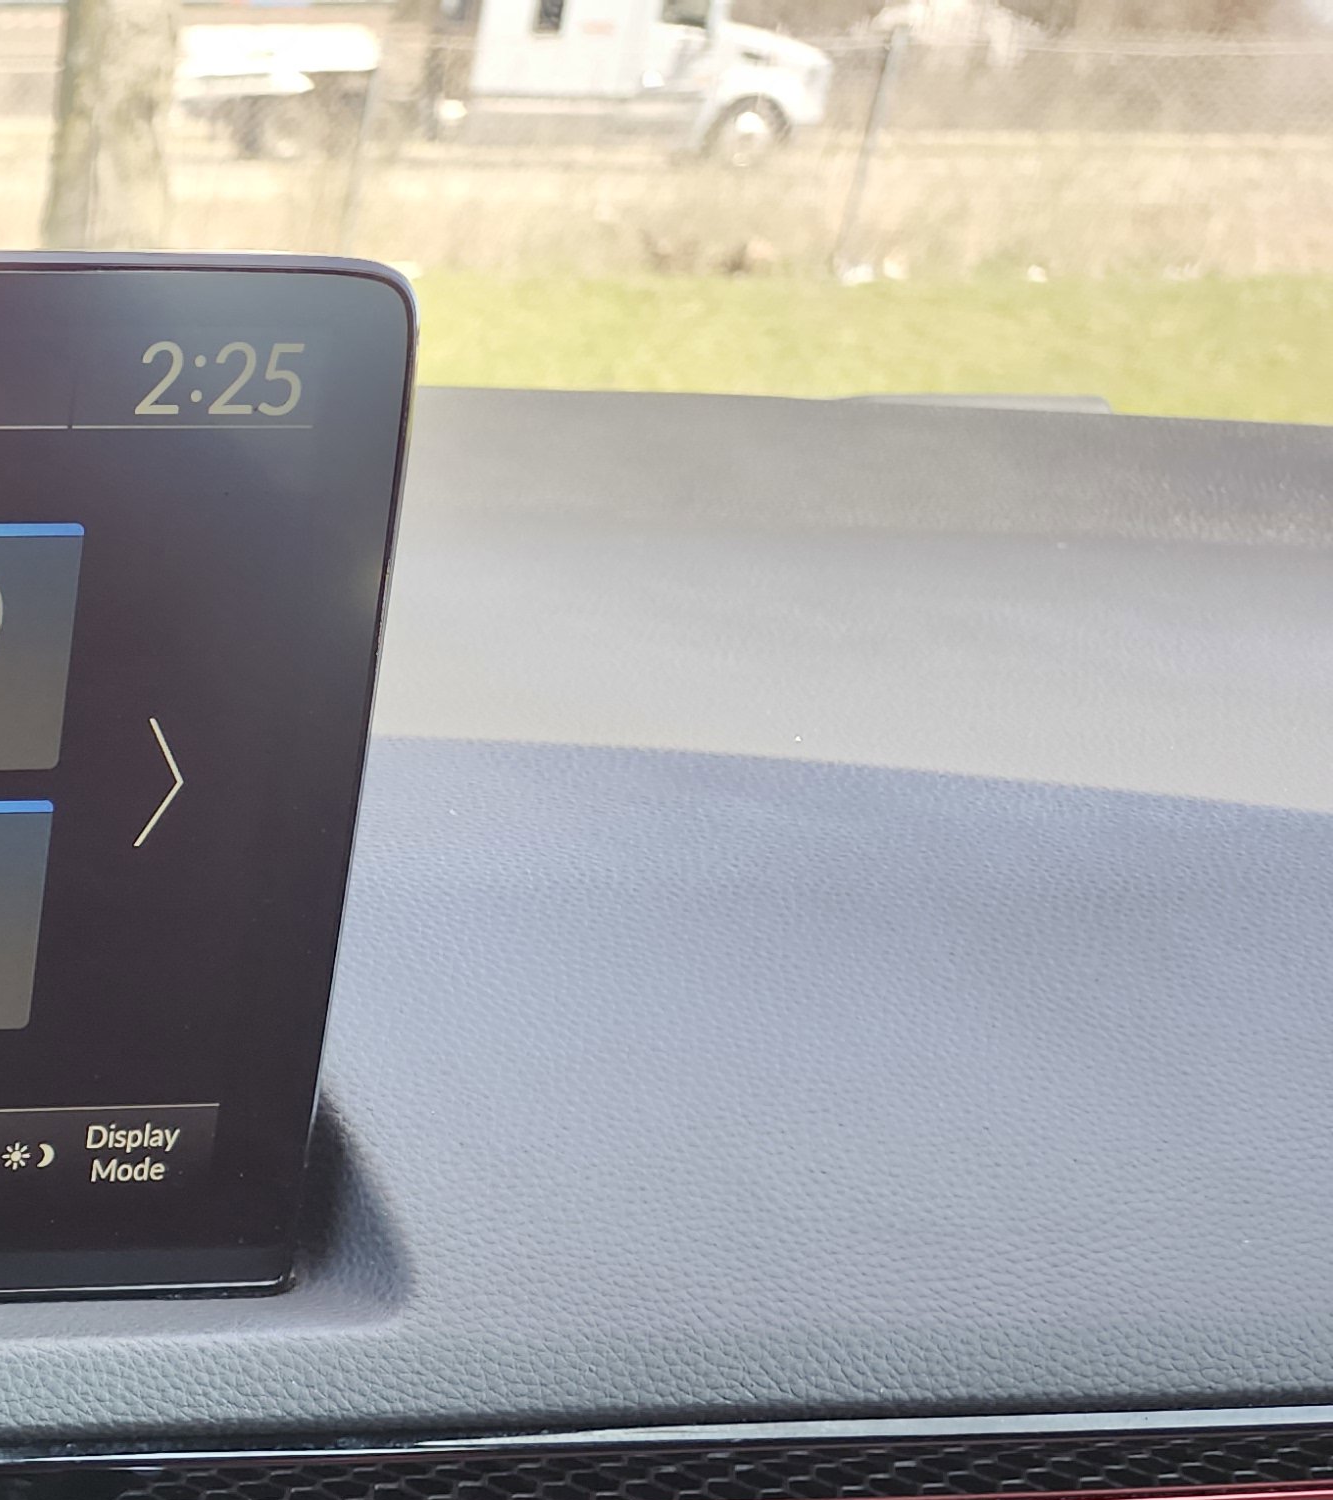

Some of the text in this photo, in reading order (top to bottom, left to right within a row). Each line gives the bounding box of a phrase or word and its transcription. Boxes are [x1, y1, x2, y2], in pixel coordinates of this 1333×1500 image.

[134, 341, 305, 416] 2:25
[86, 1122, 181, 1155] Display
[90, 1153, 170, 1182] Mode
